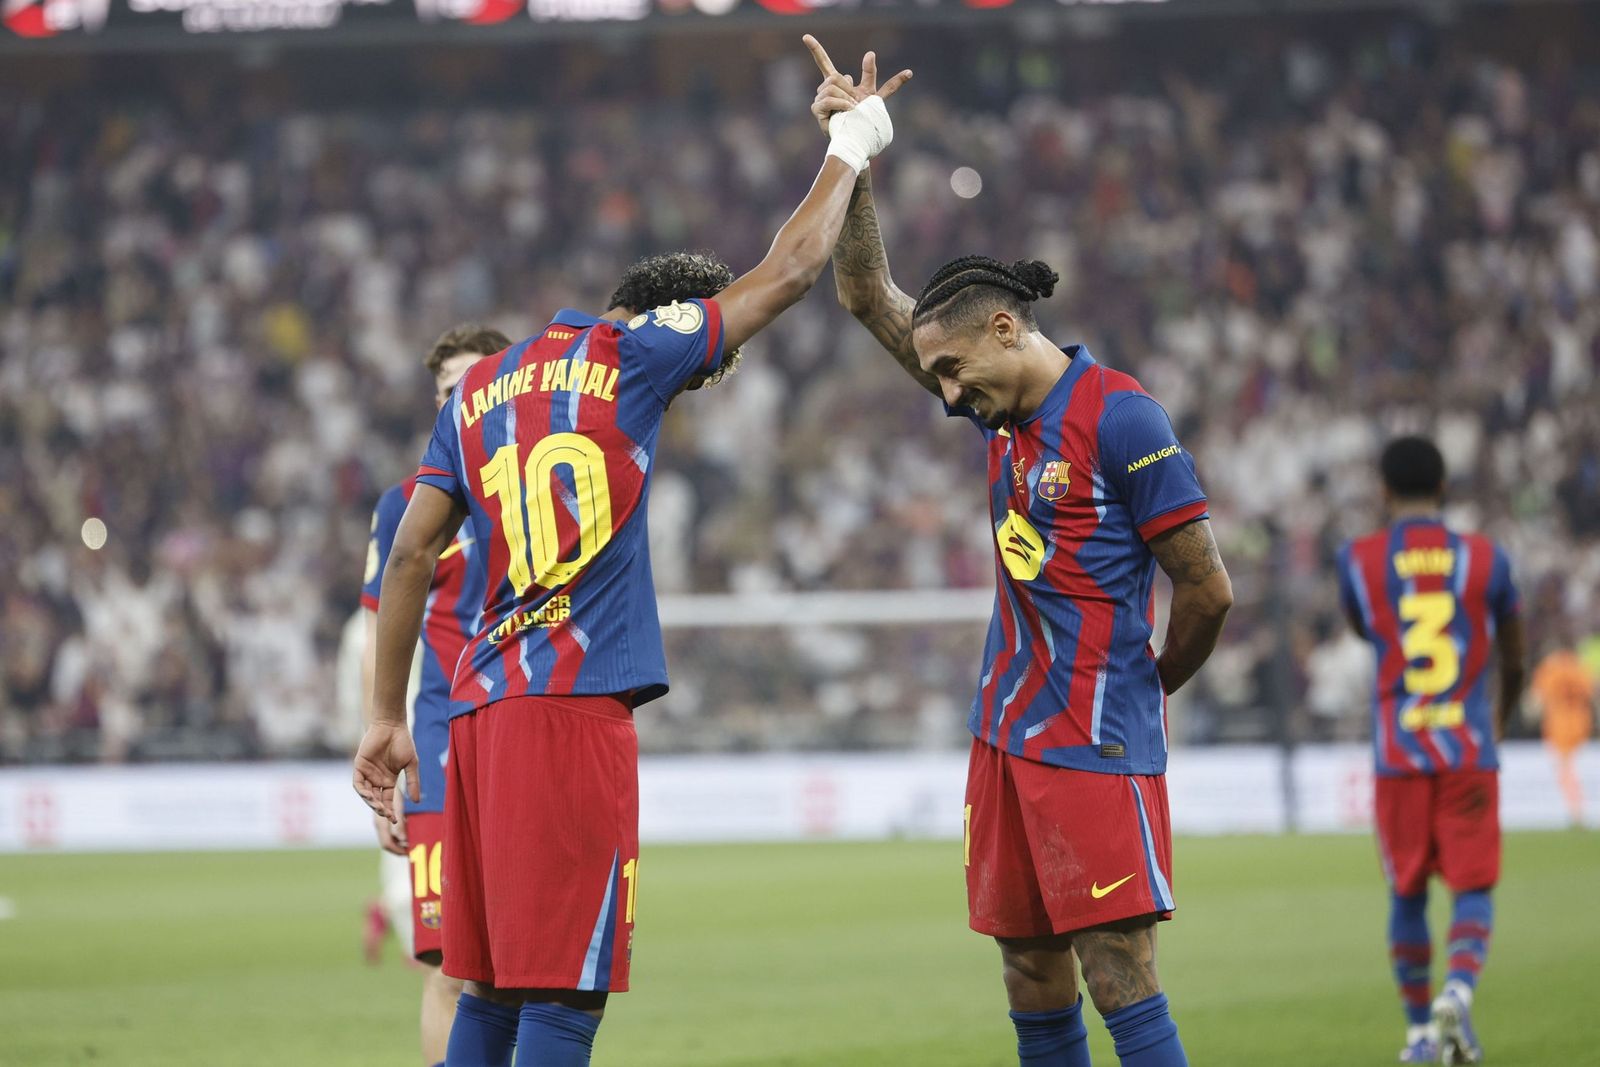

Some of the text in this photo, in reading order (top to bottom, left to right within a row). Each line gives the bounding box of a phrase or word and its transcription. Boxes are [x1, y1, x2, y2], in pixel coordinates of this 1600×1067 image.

[461, 358, 620, 428] LAMINE YAMAL
[1127, 445, 1178, 474] AMBILIGHT
[479, 432, 613, 598] 10
[1399, 591, 1460, 695] 3
[623, 857, 639, 923] 1
